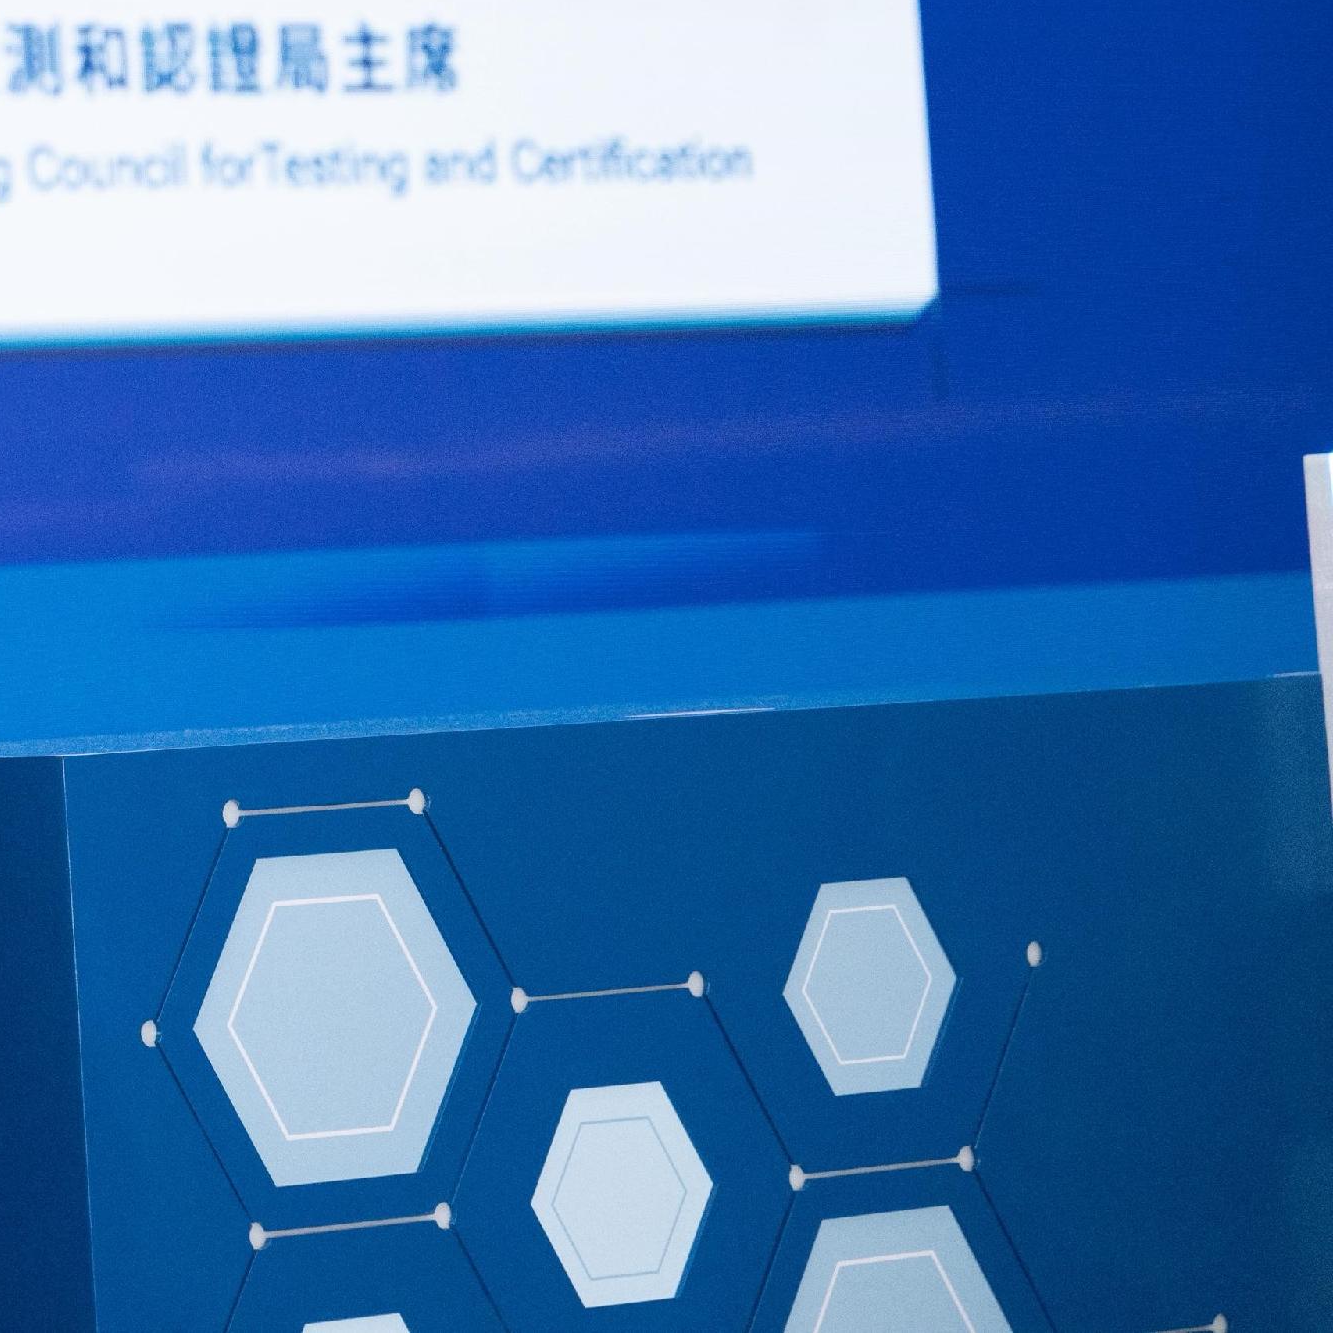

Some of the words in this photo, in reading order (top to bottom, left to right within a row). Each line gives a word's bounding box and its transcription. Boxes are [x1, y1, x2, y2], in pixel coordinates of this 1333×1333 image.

[29, 146, 185, 189] Council
[424, 142, 497, 185] and
[511, 136, 753, 184] Certification
